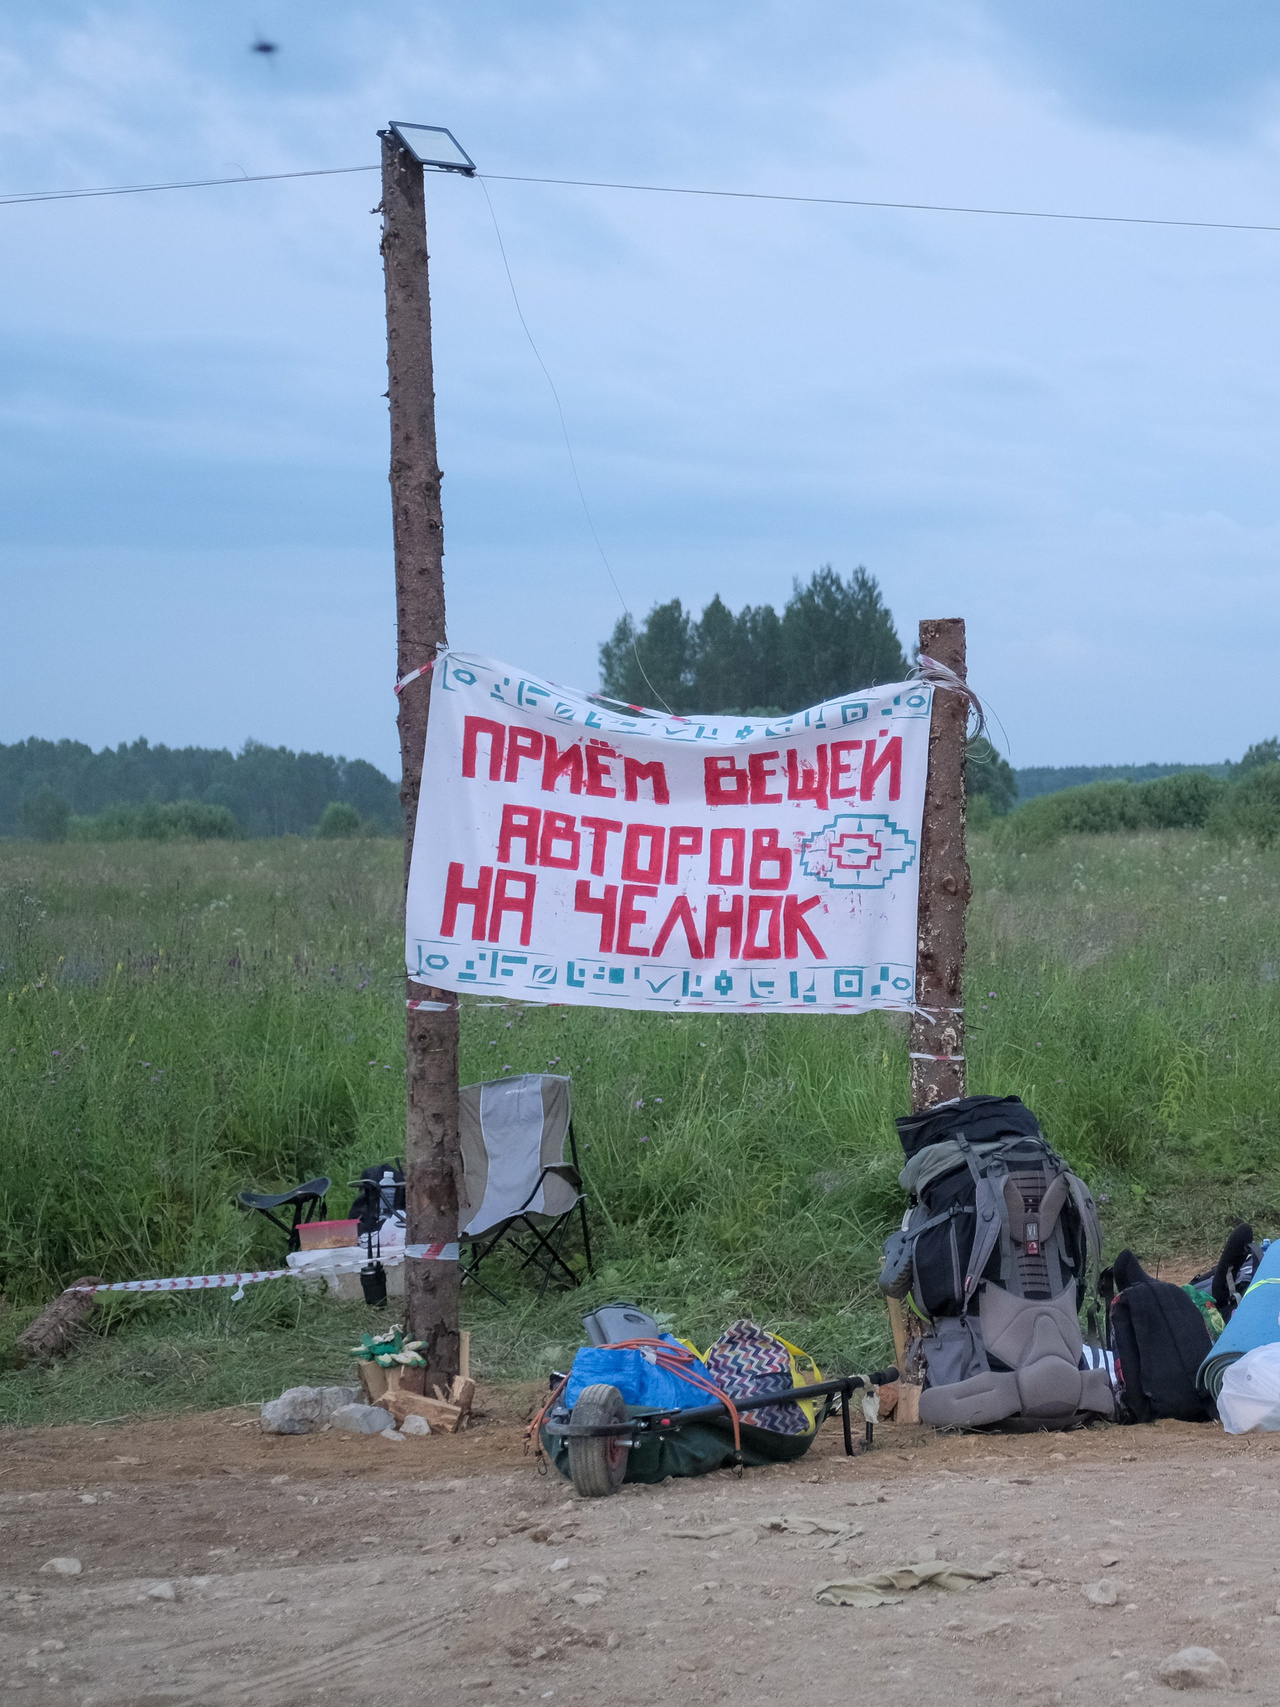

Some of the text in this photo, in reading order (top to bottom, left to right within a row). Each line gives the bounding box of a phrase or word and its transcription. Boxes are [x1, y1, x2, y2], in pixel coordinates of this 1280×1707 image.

[462, 715, 903, 811] ПРИЁМ ВЕЩЕЙ
[497, 803, 793, 891] АВТОРОВ
[439, 862, 827, 960] НА ЧЕЛНОК
